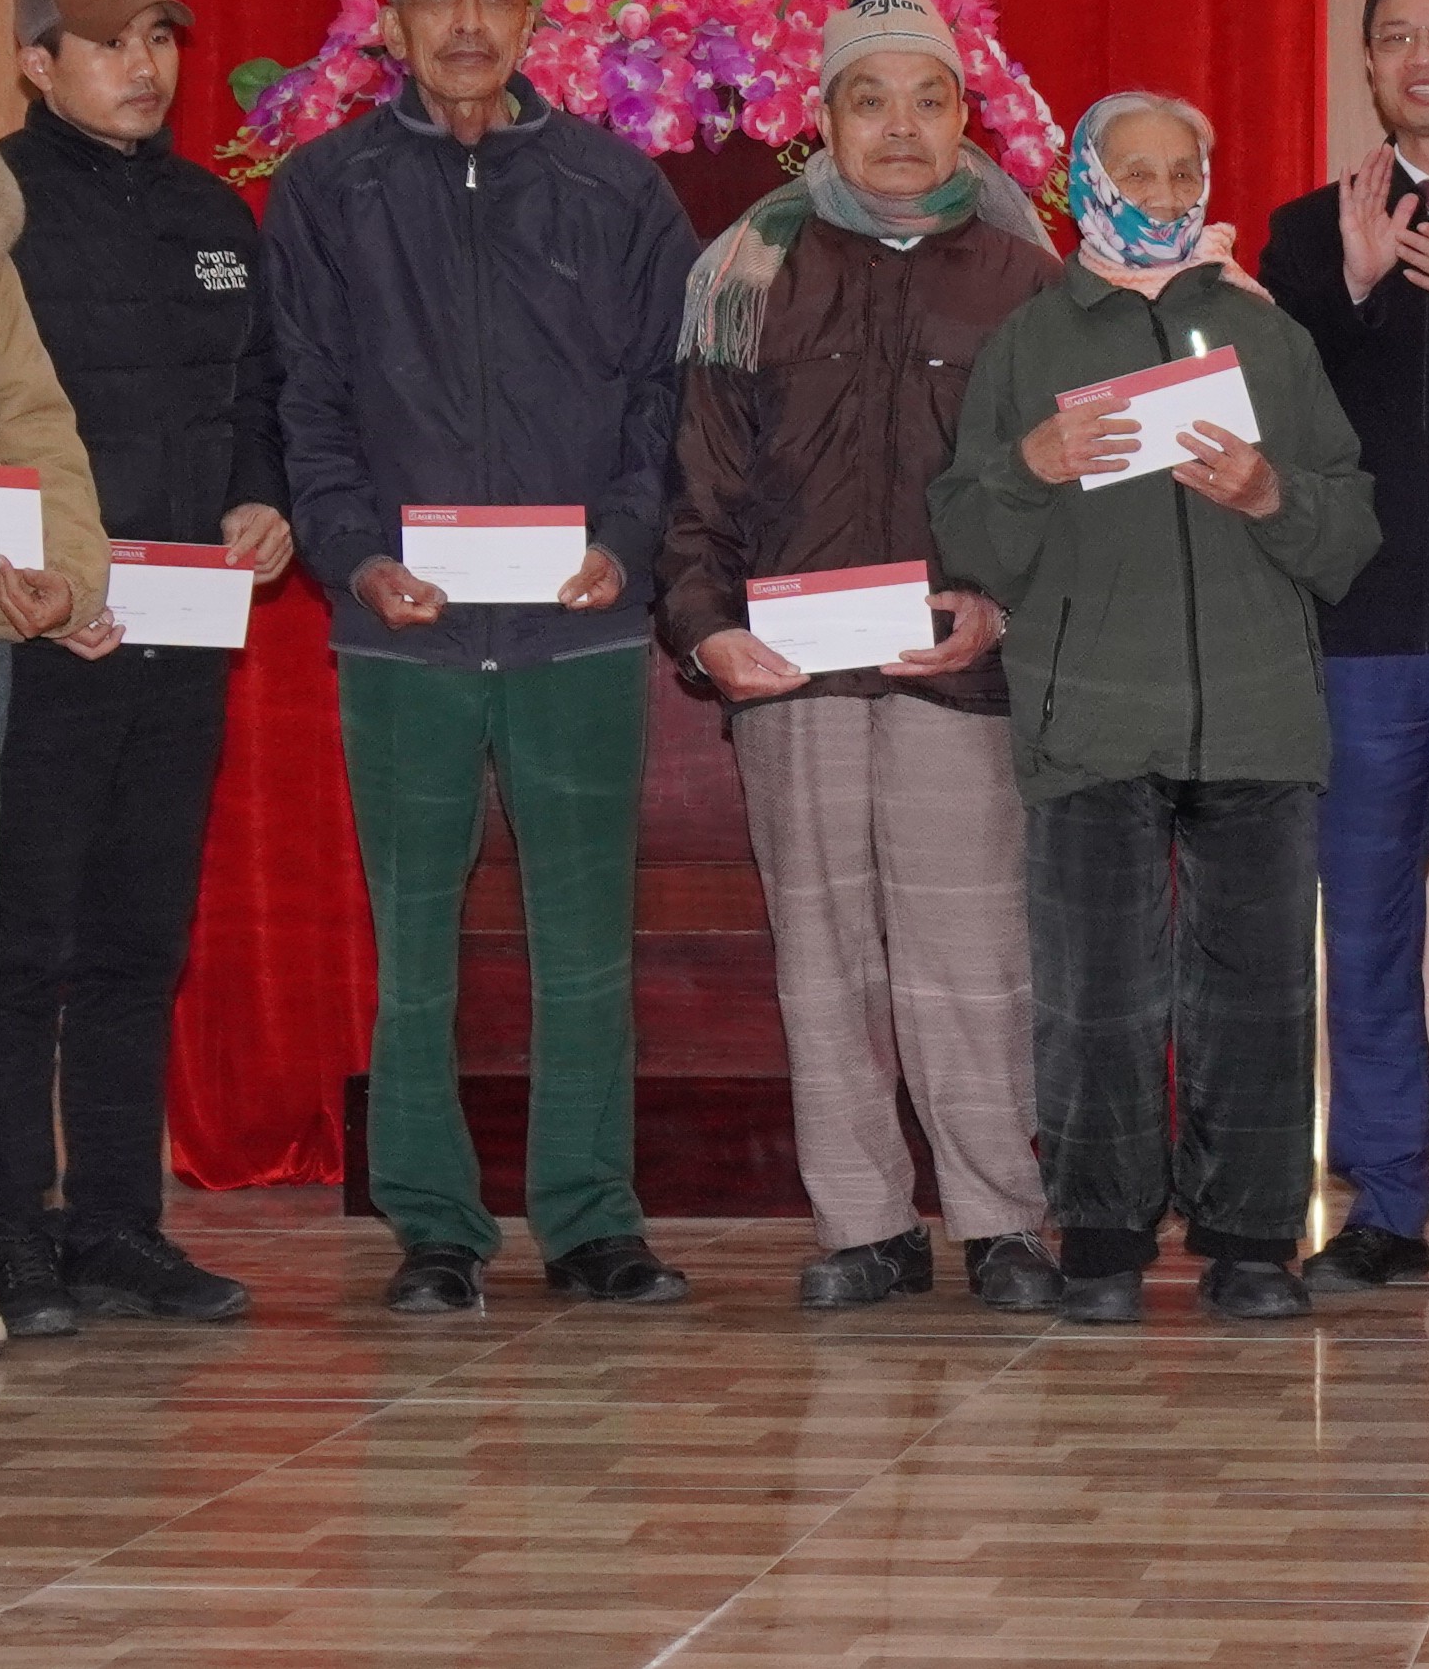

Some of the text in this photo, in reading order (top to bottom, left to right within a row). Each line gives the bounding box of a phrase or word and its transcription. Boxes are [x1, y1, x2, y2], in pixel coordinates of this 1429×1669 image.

[1072, 391, 1111, 405] AGRIBANK
[416, 514, 458, 523] AGRIBANK
[762, 582, 801, 593] AGRIBANK
